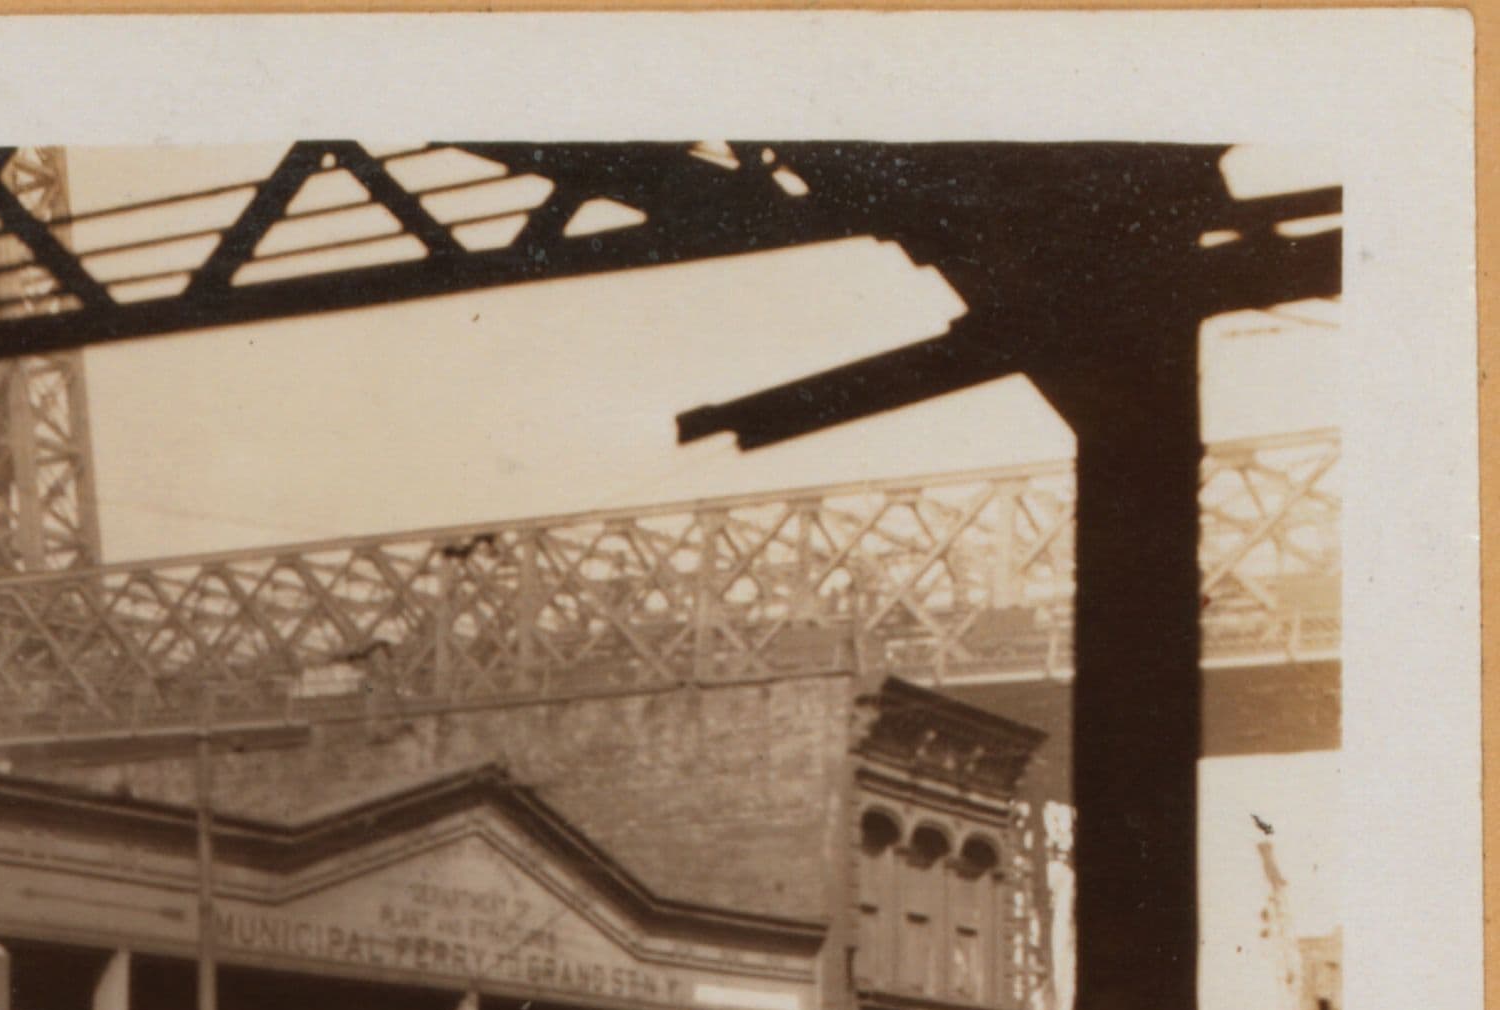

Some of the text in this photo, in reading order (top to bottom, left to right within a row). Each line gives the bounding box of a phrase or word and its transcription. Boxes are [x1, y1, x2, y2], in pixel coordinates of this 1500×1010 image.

[379, 903, 431, 930] PLANT
[214, 909, 383, 963] MUNICIPAL
[395, 935, 488, 979] FERRY
[527, 955, 602, 993] GRAND
